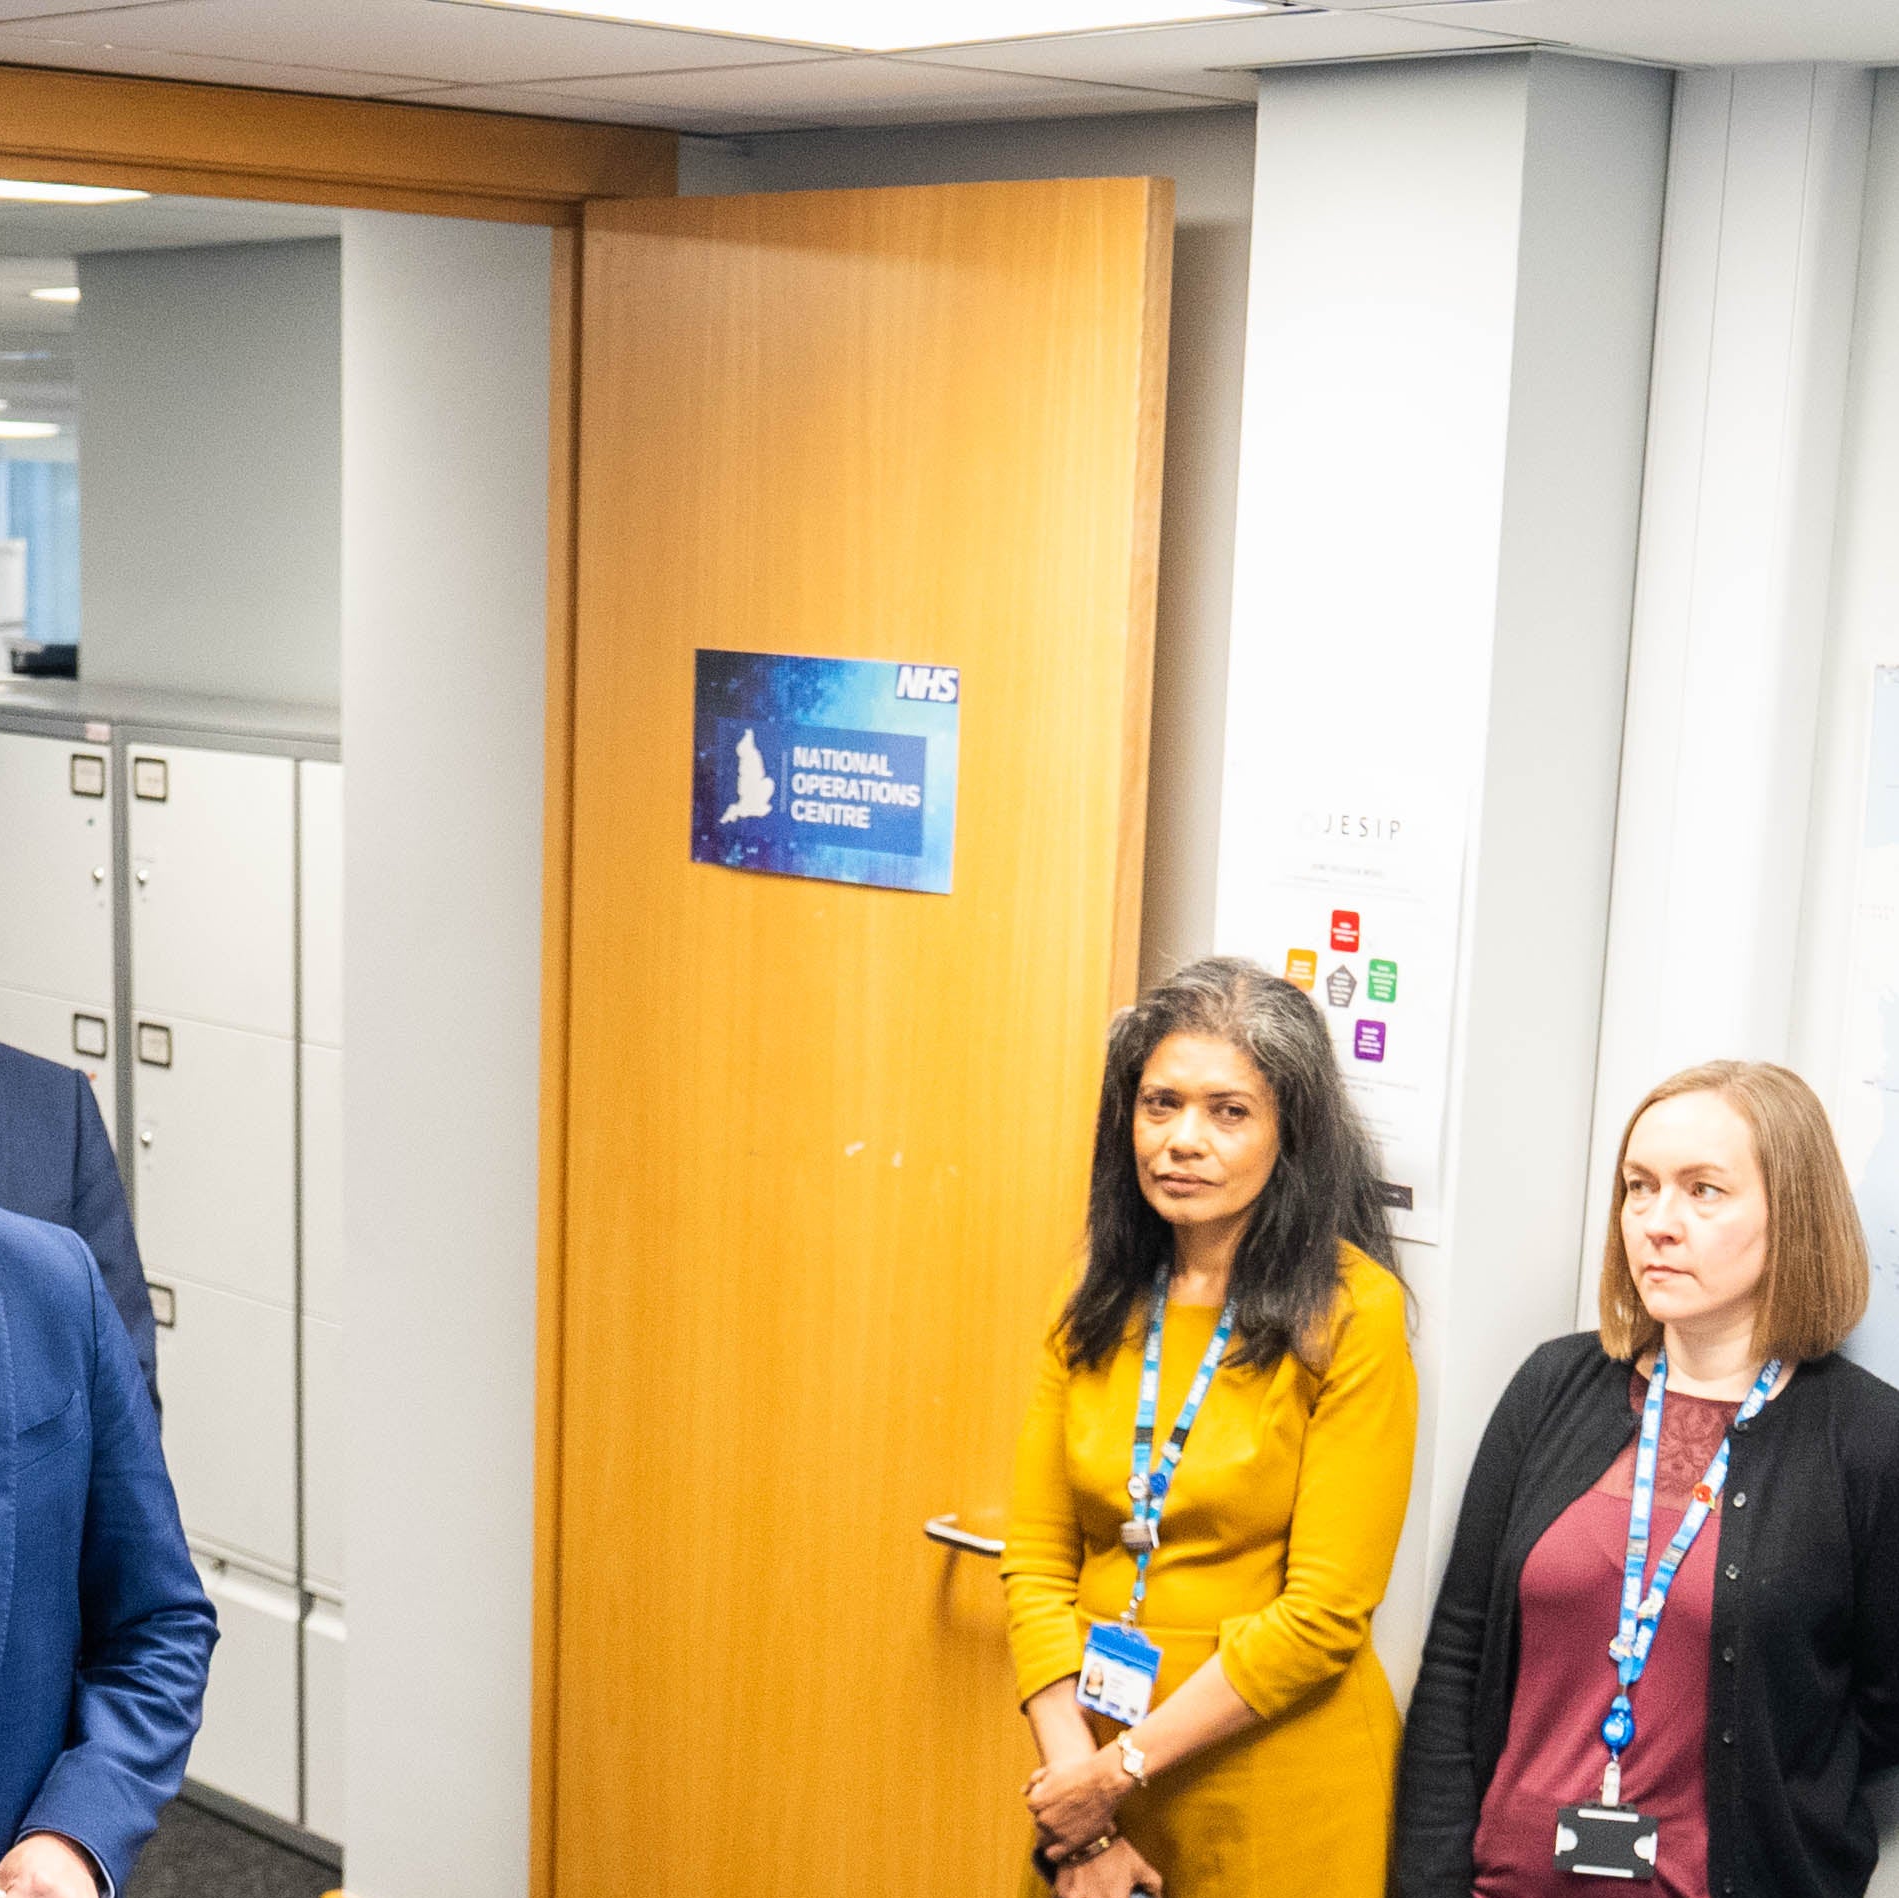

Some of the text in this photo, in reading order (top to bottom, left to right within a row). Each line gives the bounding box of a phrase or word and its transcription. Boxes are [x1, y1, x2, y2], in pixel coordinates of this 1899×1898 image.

[895, 665, 959, 703] NHS
[793, 745, 894, 777] NATIONAL
[791, 772, 921, 808] OPERATIONS
[790, 799, 871, 830] CENTRE
[1323, 813, 1401, 841] JESIP
